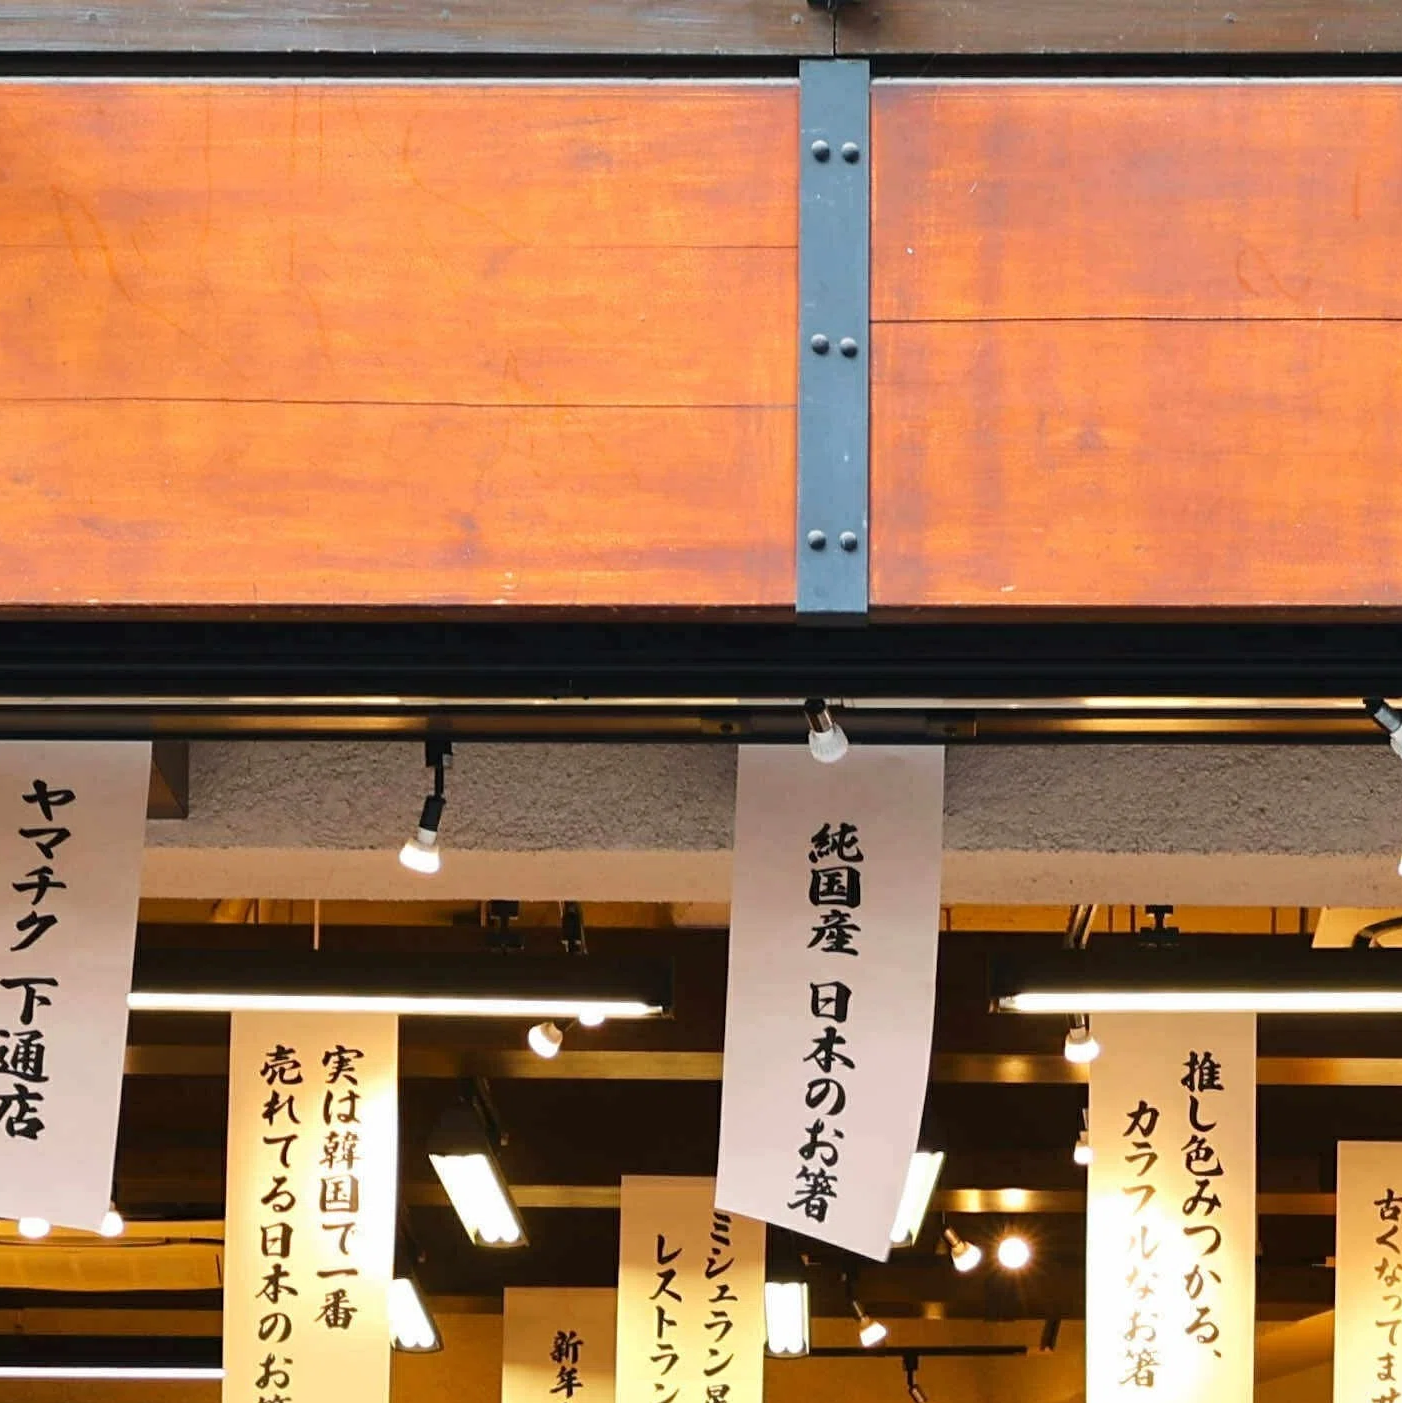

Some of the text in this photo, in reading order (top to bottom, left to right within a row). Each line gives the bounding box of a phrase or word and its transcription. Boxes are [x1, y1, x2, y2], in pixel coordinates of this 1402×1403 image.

[10, 780, 76, 952] ヤマチク
[787, 823, 864, 1224] 純国産 日本のお箸
[314, 1044, 365, 1330] 実は韓国で一番
[1118, 1100, 1162, 1388] カラフルなお箸
[1181, 1051, 1225, 1360] 推し色みつかる、
